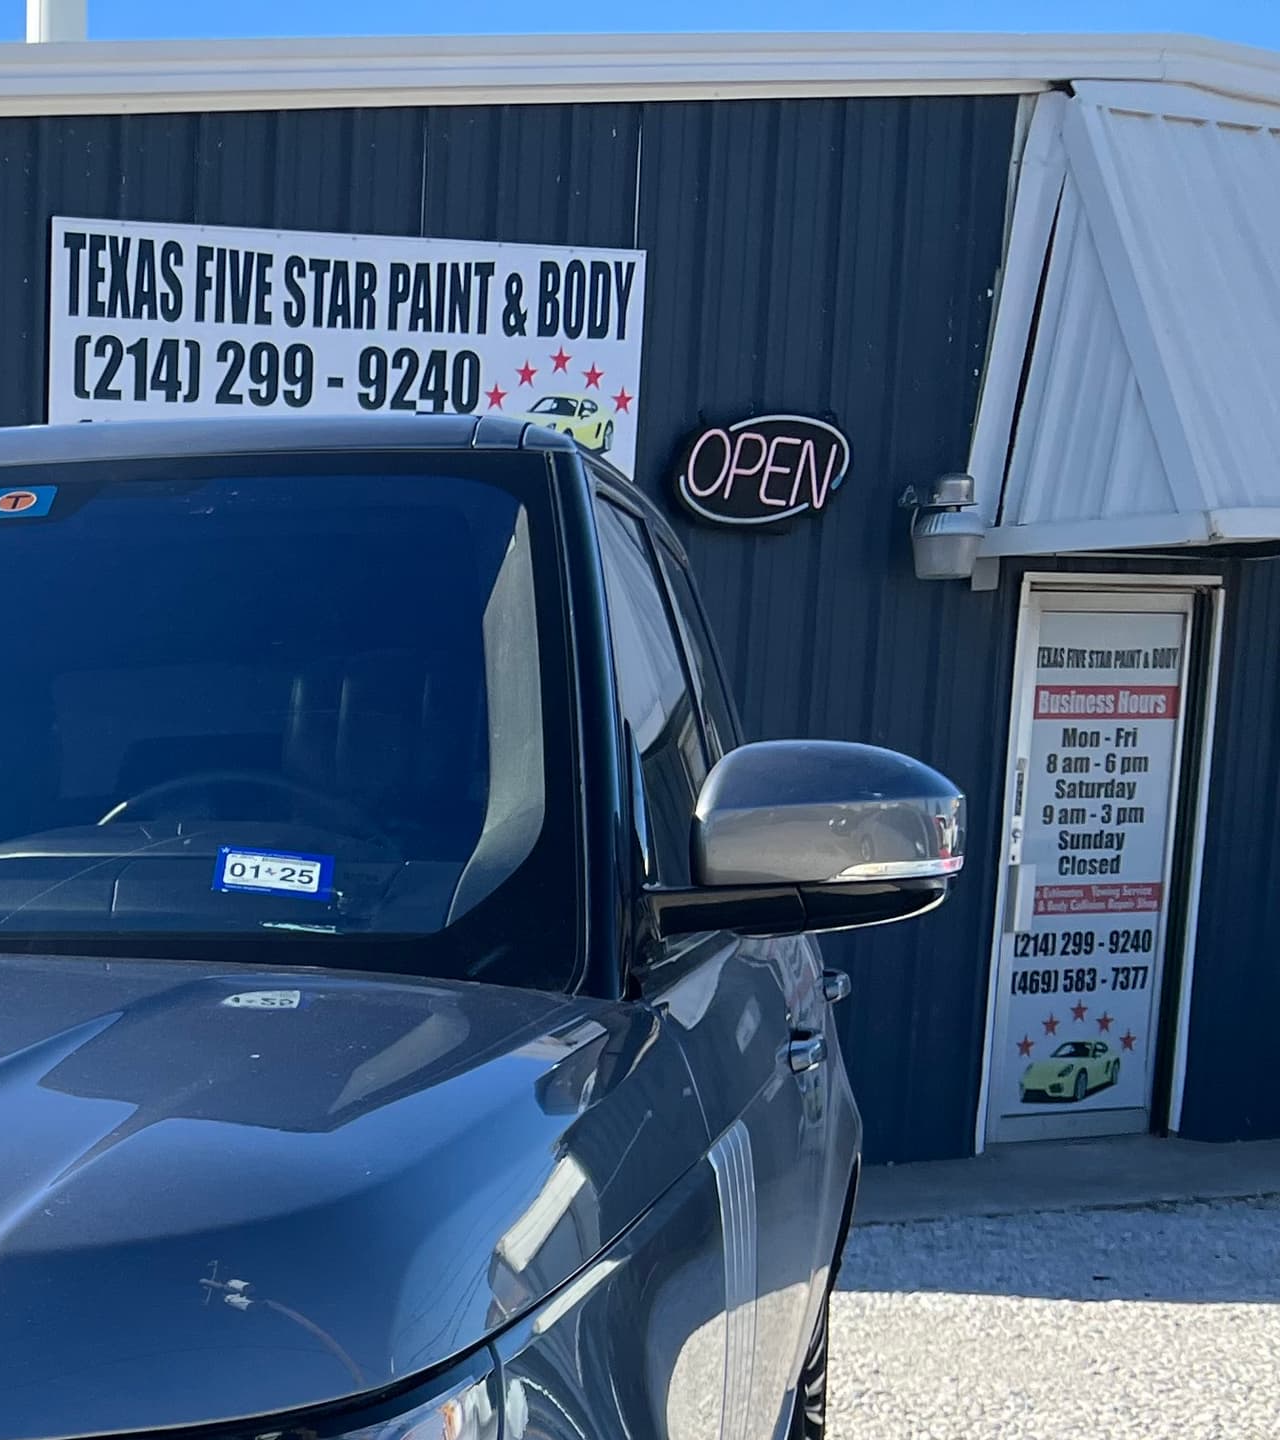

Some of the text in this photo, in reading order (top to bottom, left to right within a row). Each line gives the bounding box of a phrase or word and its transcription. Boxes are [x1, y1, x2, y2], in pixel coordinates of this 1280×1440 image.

[64, 232, 636, 340] TEXAS FIVE STAR PAINT & BODY
[74, 334, 200, 403] (214)
[216, 340, 314, 408] 299
[357, 346, 480, 414] 9240
[688, 428, 837, 509] OPEN
[5, 495, 33, 509] T
[1037, 646, 1065, 668] TEXAS
[1067, 648, 1086, 668] FIVE
[1088, 649, 1112, 668] STAR
[1114, 649, 1142, 668] PAINT
[1152, 648, 1179, 668] BODY
[1039, 690, 1166, 713] Business Hours
[1062, 728, 1100, 747] Mon
[1115, 728, 1138, 747] Fri
[1046, 753, 1057, 773] 8
[1062, 756, 1090, 773] am
[1105, 753, 1116, 773] 6
[1121, 756, 1148, 774] pm
[1055, 779, 1136, 800] Saturday
[1043, 805, 1054, 825] 9
[1058, 808, 1086, 824] am
[1101, 804, 1112, 823] 3
[1116, 807, 1144, 825] pm
[1058, 830, 1125, 850] Sunday
[230, 863, 313, 884] 01 25
[1059, 855, 1120, 875] Closed
[1014, 932, 1056, 957] (214)
[1060, 931, 1094, 956] 299
[1109, 929, 1152, 953] 9240
[1011, 970, 1058, 995] (469)
[1063, 968, 1096, 992] 583
[1111, 966, 1148, 991] 7377
